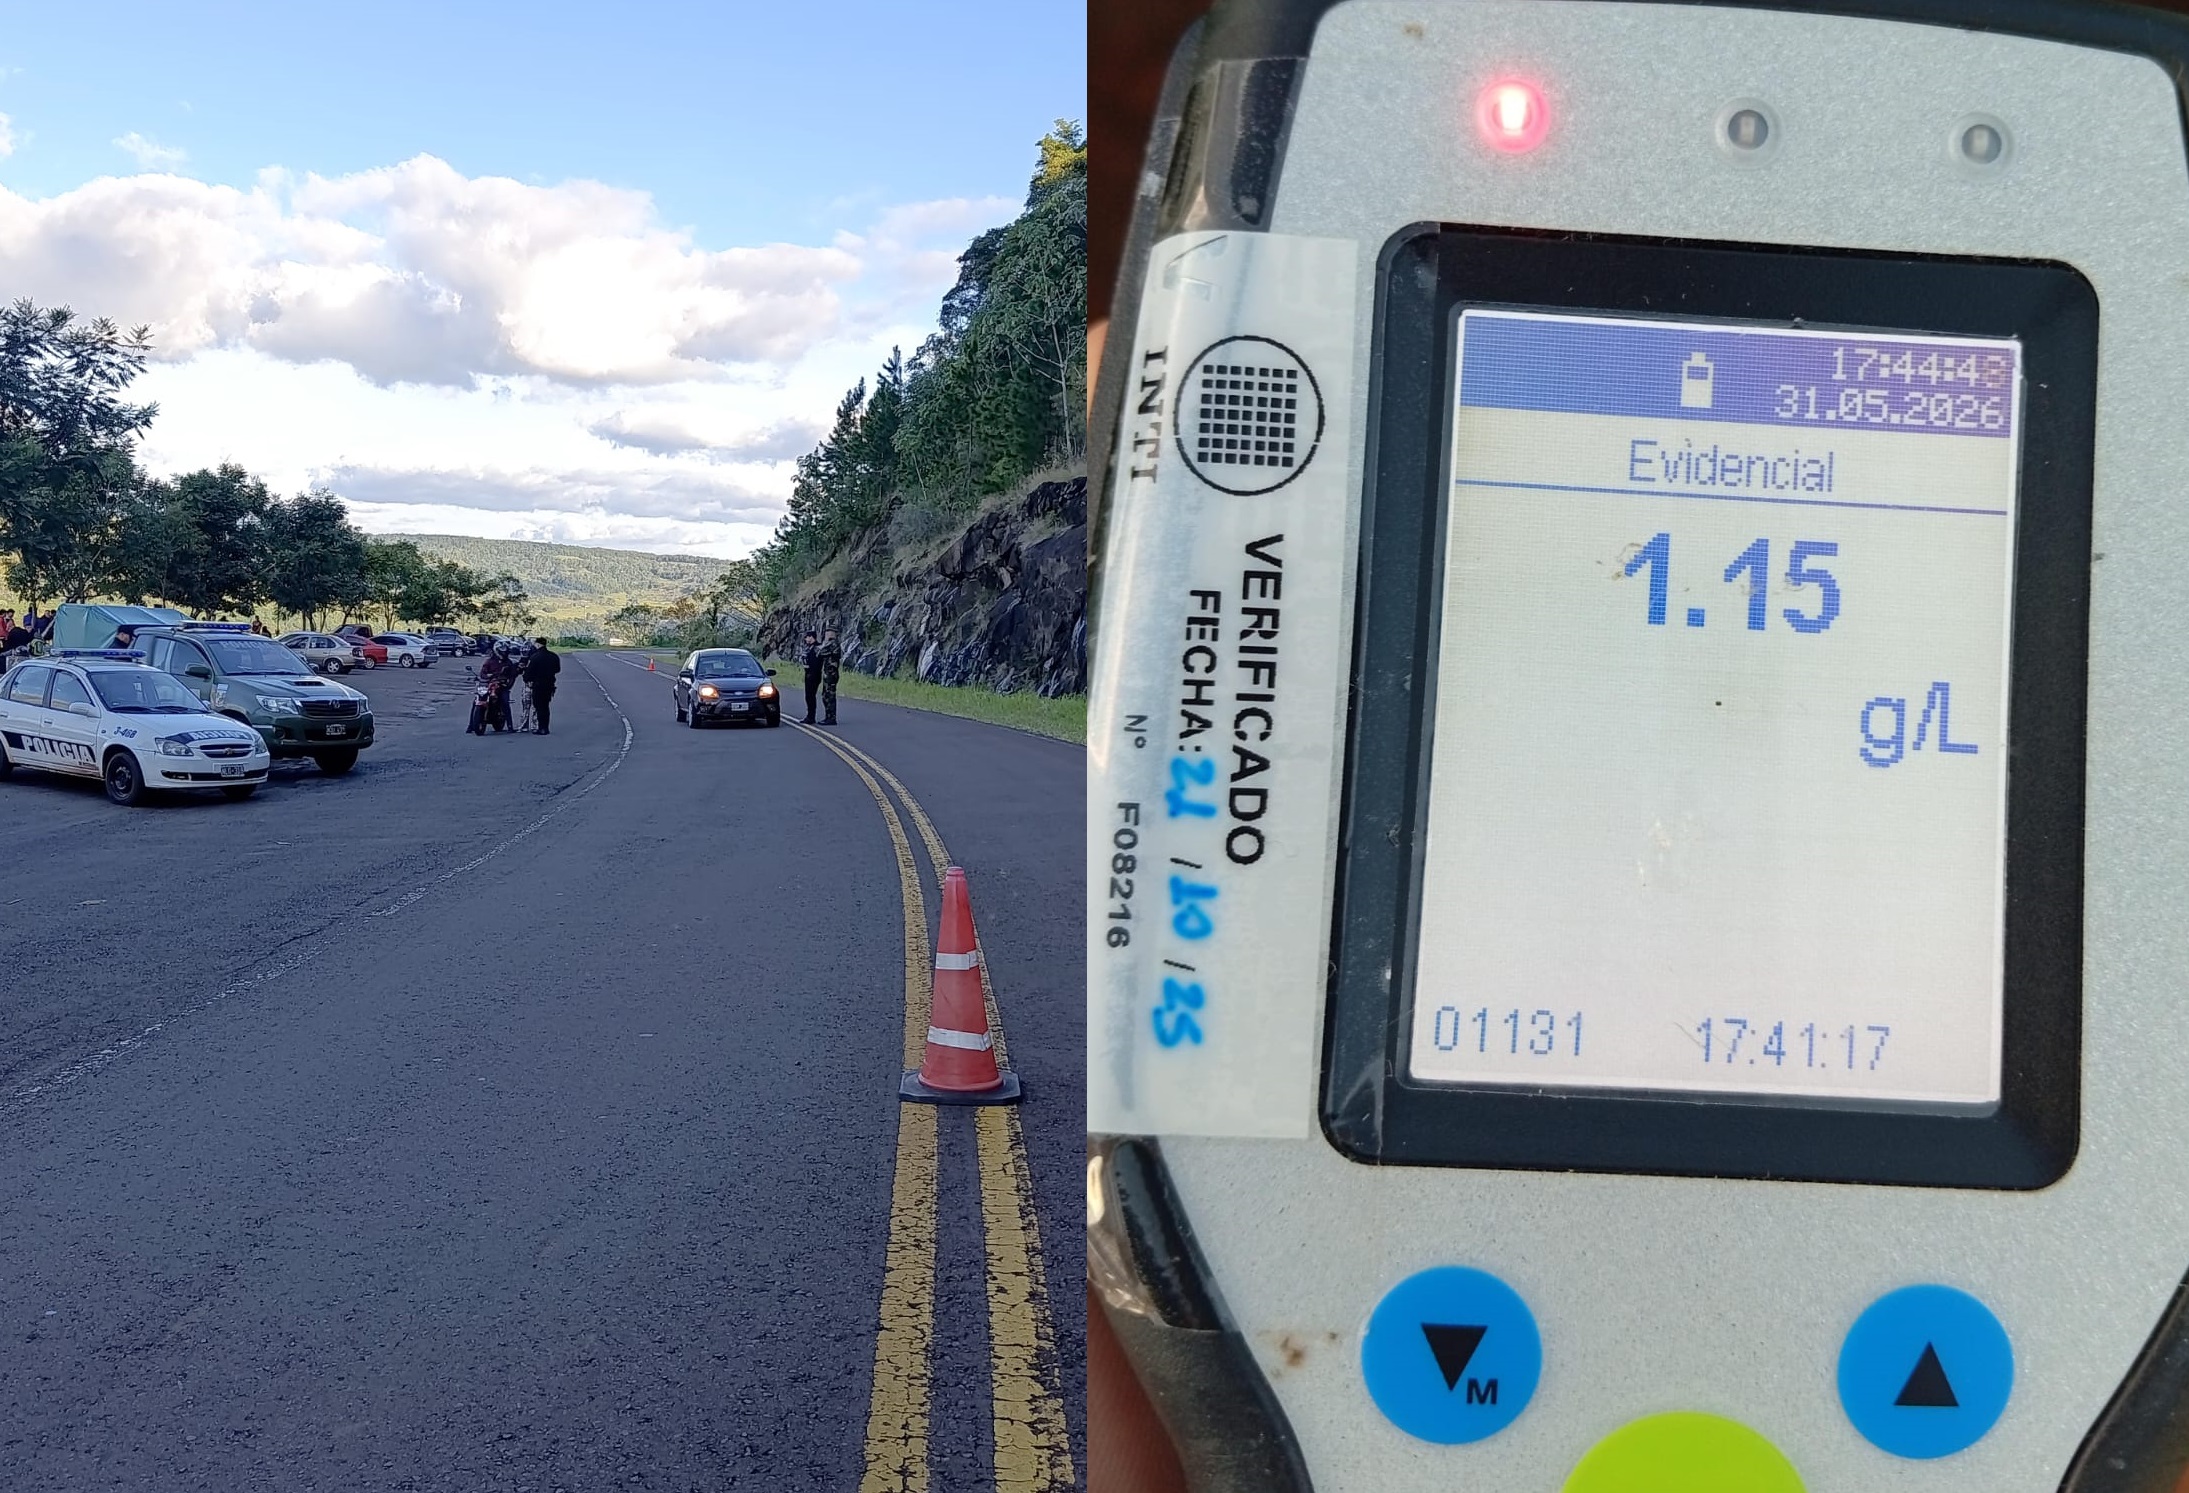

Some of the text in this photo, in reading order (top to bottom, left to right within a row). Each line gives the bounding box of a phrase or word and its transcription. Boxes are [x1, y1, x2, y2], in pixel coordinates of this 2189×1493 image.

[1131, 345, 1168, 483] INTI
[1775, 385, 2005, 429] 31.05.2026
[1629, 438, 1834, 492] Evidencial
[1624, 532, 1840, 634] 1.15
[1178, 589, 1221, 752] FECHA:
[1226, 534, 1284, 865] VERIFICADO
[21, 735, 95, 763] POLICIA
[1859, 682, 1978, 768] g/L
[1106, 802, 1140, 948] F08216
[1434, 1005, 1890, 1071] 01131 17:41:17
[1466, 1378, 1498, 1405] M
